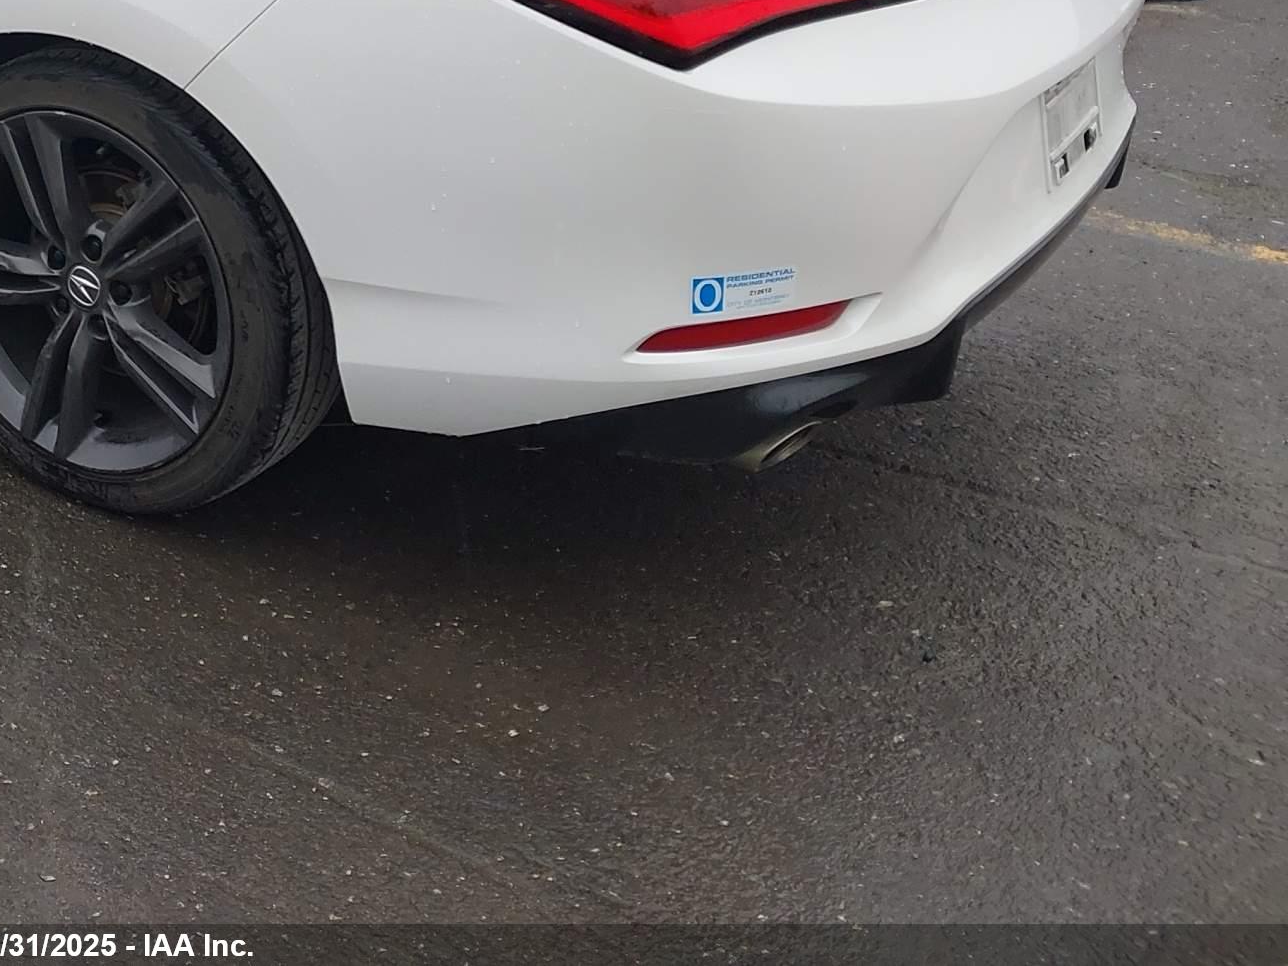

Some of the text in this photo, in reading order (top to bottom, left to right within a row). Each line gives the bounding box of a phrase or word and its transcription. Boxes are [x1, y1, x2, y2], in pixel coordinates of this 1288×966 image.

[726, 268, 796, 283] RESIDENTIAL
[726, 274, 794, 289] PARKING PERMIT
